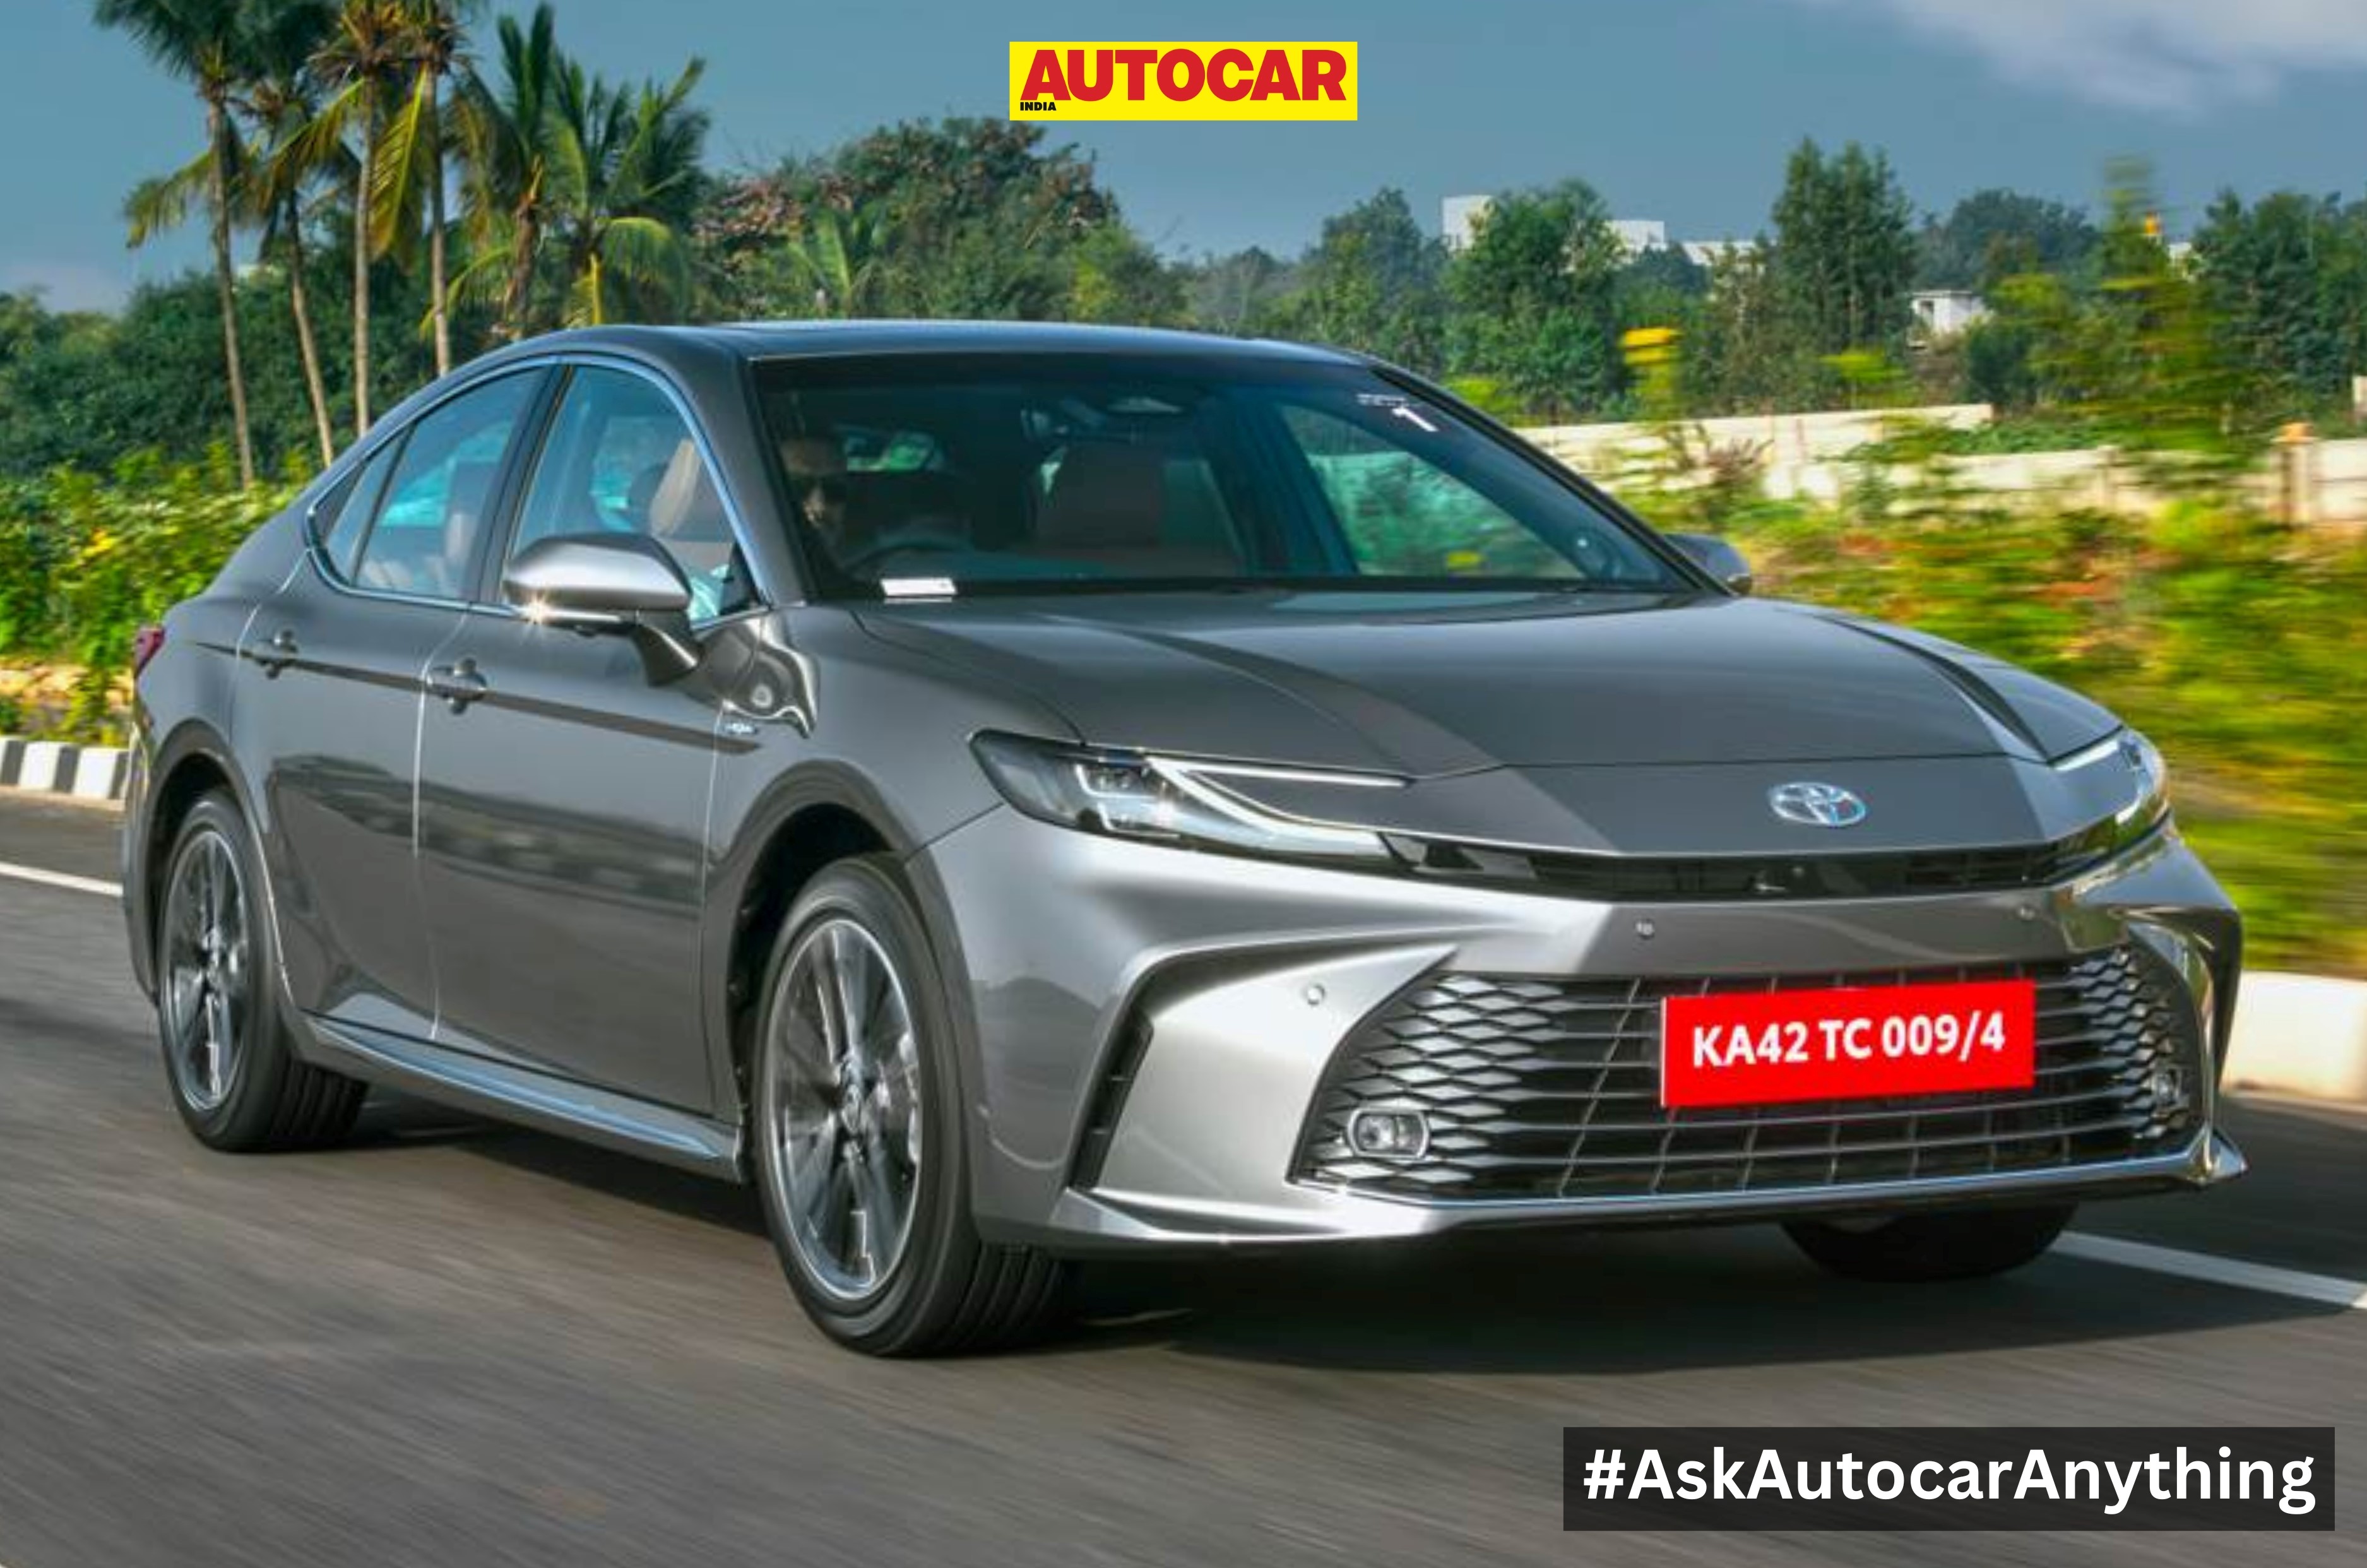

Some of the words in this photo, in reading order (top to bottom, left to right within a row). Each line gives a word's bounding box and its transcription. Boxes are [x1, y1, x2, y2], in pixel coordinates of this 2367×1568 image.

[1694, 1021, 1809, 1068] KA42
[1818, 1018, 1872, 1060] TC
[1882, 1011, 2005, 1062] 009/4
